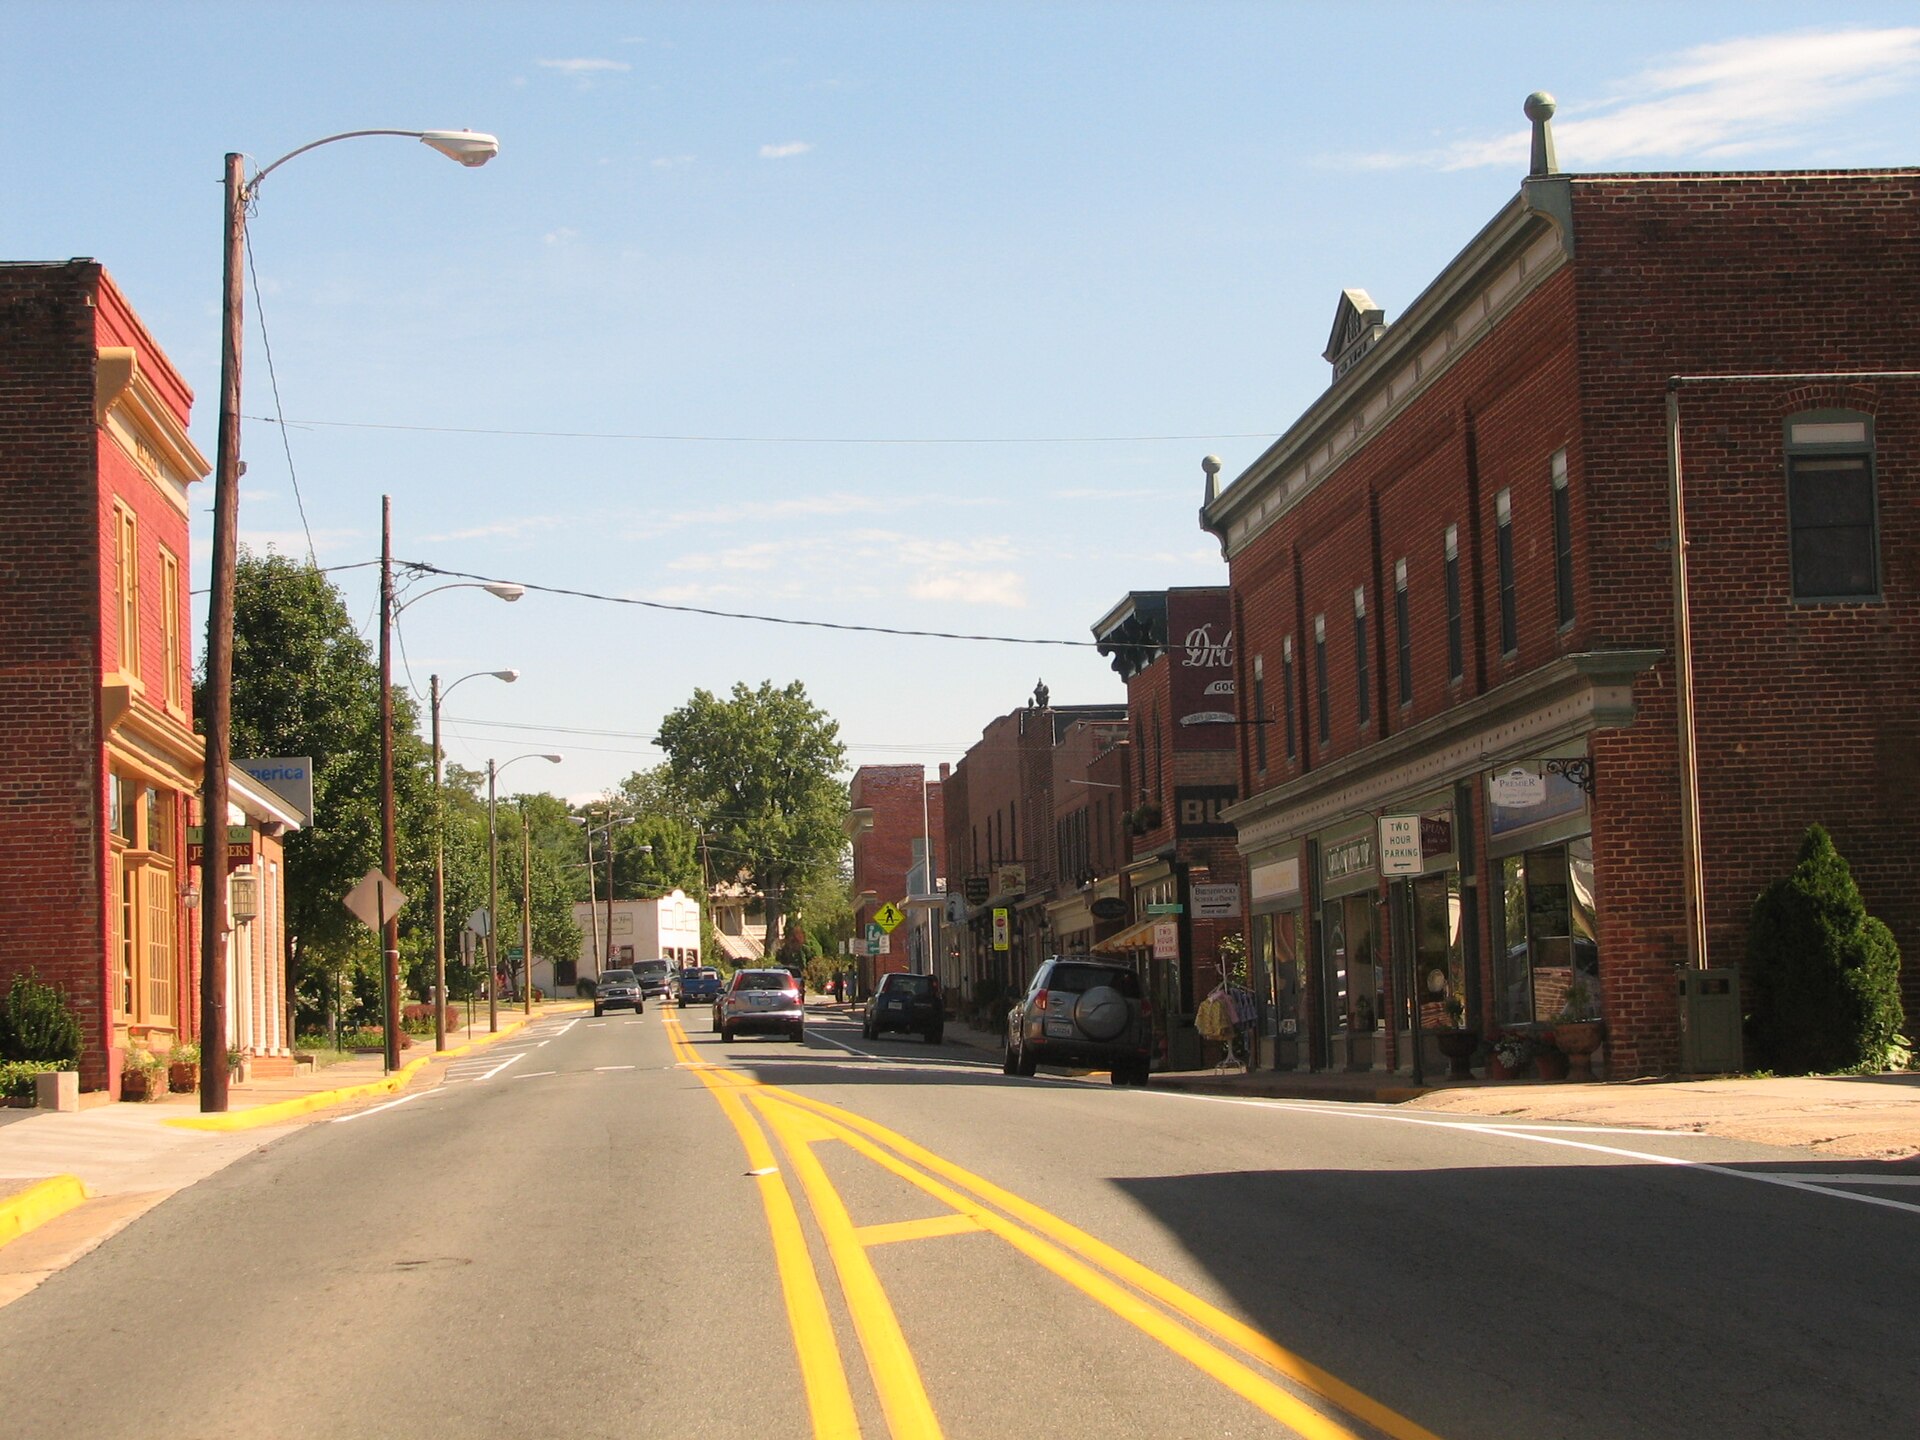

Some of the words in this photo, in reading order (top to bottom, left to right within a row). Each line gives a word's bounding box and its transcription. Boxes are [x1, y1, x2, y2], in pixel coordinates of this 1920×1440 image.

[247, 764, 304, 780] merica
[1390, 822, 1409, 831] TWO
[1390, 835, 1411, 845] HOUR
[190, 844, 250, 861] JEERS
[1385, 848, 1418, 858] PARKING
